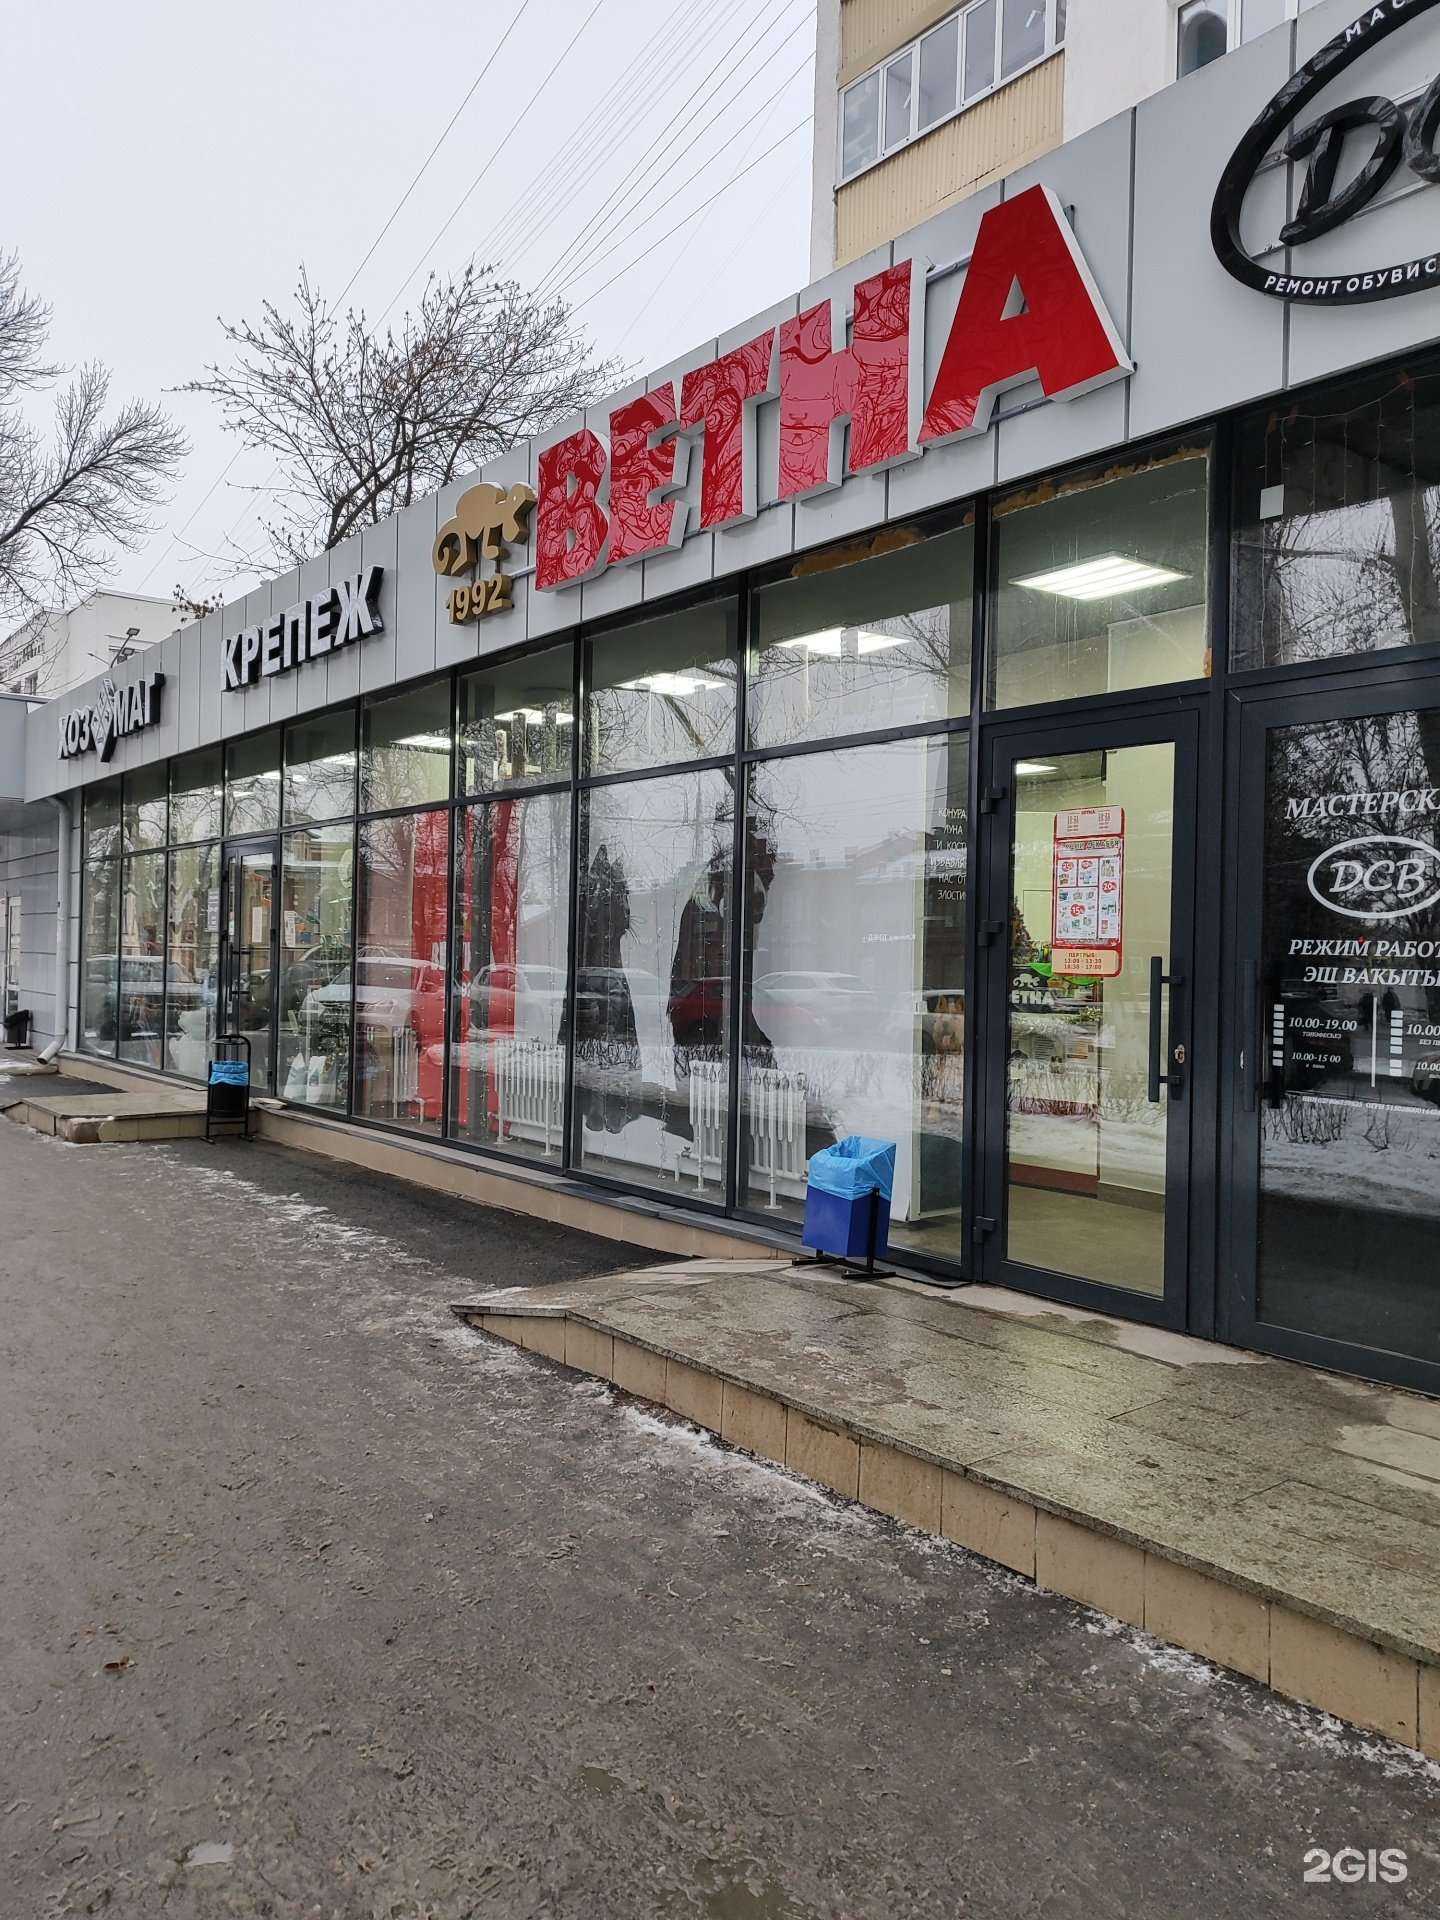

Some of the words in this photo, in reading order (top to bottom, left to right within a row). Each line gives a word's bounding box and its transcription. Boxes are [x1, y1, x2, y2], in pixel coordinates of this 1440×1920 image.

[1264, 275, 1342, 295] РЕМОНТ
[536, 184, 1130, 592] ВЕТНА
[446, 573, 512, 625] 1992
[221, 566, 384, 692] КРЕПЕЖ
[58, 705, 94, 760] ХОЗ
[112, 672, 162, 738] МАГ
[1285, 788, 1440, 819] МАСТЕРСК
[943, 825, 963, 835] ЛУНА
[938, 874, 953, 884] НАС
[1288, 939, 1369, 957] РЕЖИМ
[1303, 966, 1338, 983] ЭШ
[1010, 989, 1055, 1005] ЕТНА
[1289, 1017, 1358, 1031] 10.00-19.00
[1292, 1052, 1342, 1063] 10.00-1500
